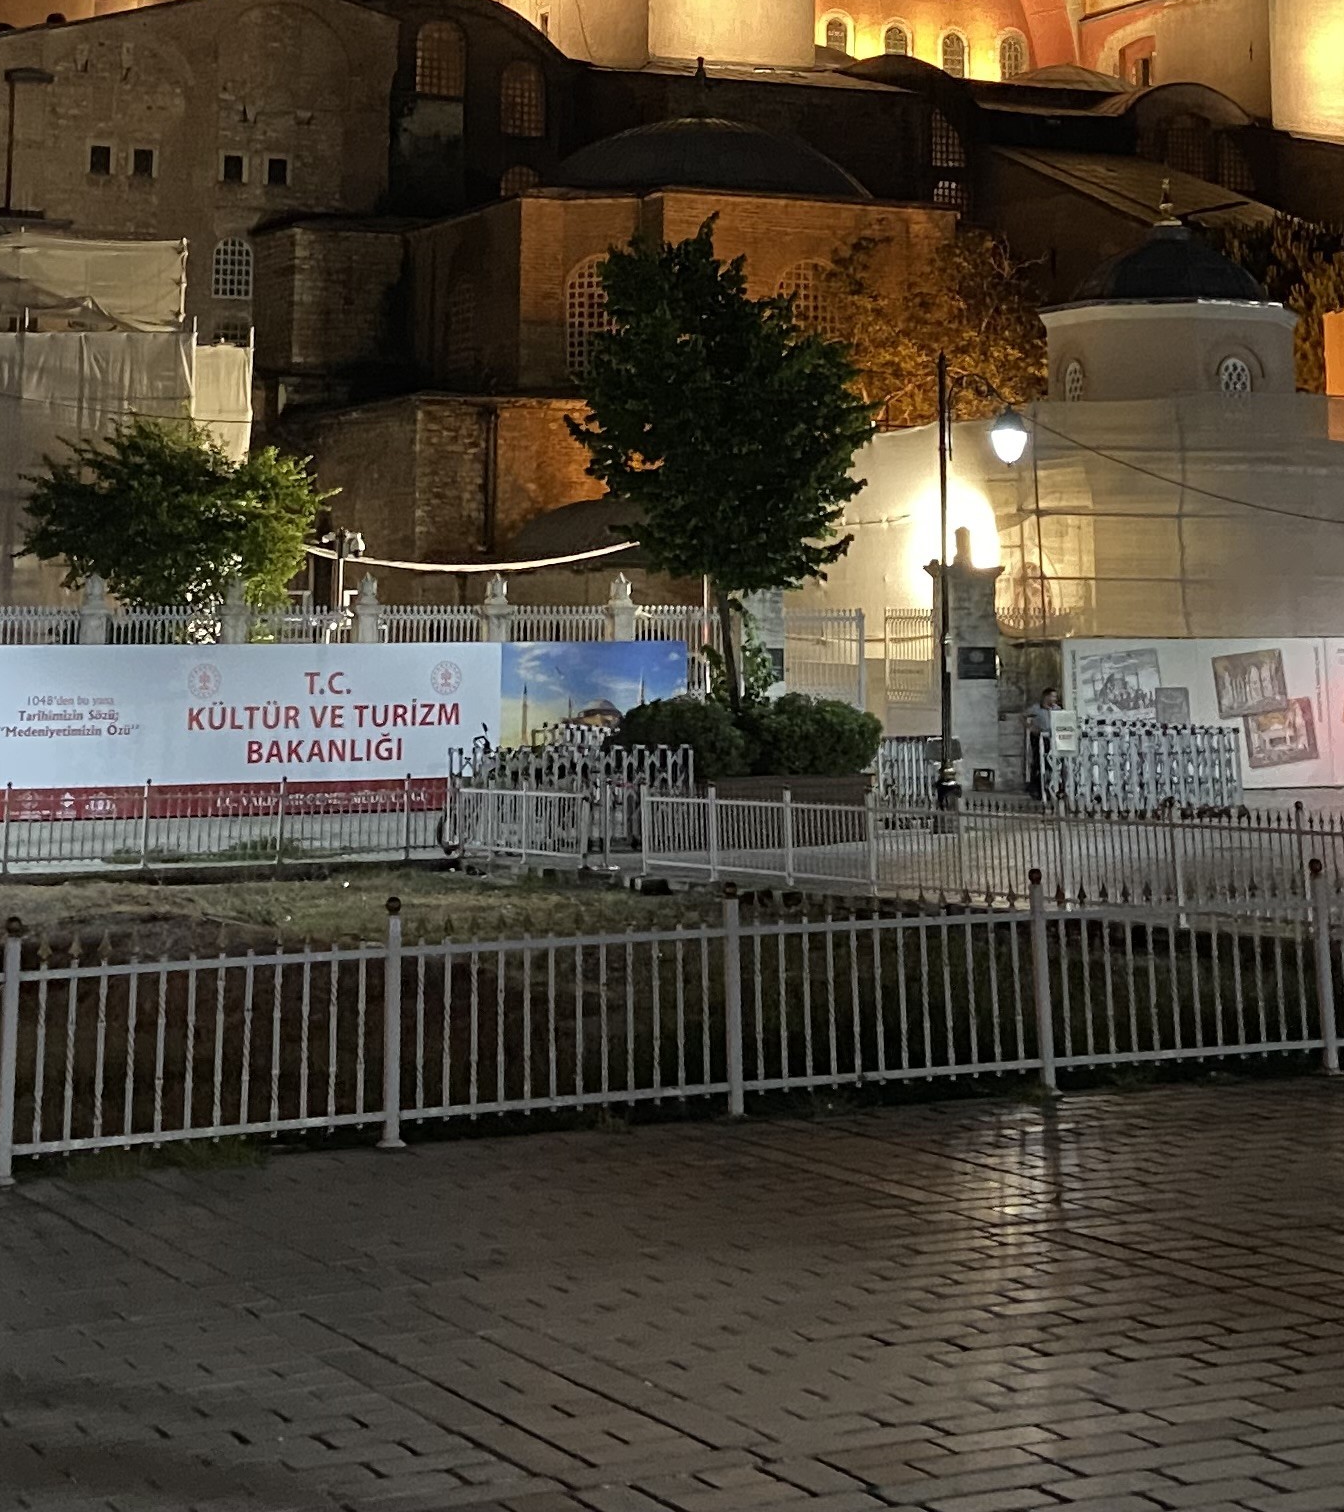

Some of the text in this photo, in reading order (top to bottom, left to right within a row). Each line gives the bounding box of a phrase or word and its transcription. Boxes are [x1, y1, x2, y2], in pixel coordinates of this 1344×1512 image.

[304, 671, 352, 695] T.C.
[77, 694, 90, 706] bu
[18, 709, 83, 722] Tarihimizin
[187, 697, 460, 731] KÜLTÜR VE TURİZM
[246, 732, 403, 765] BAKANLIĞI
